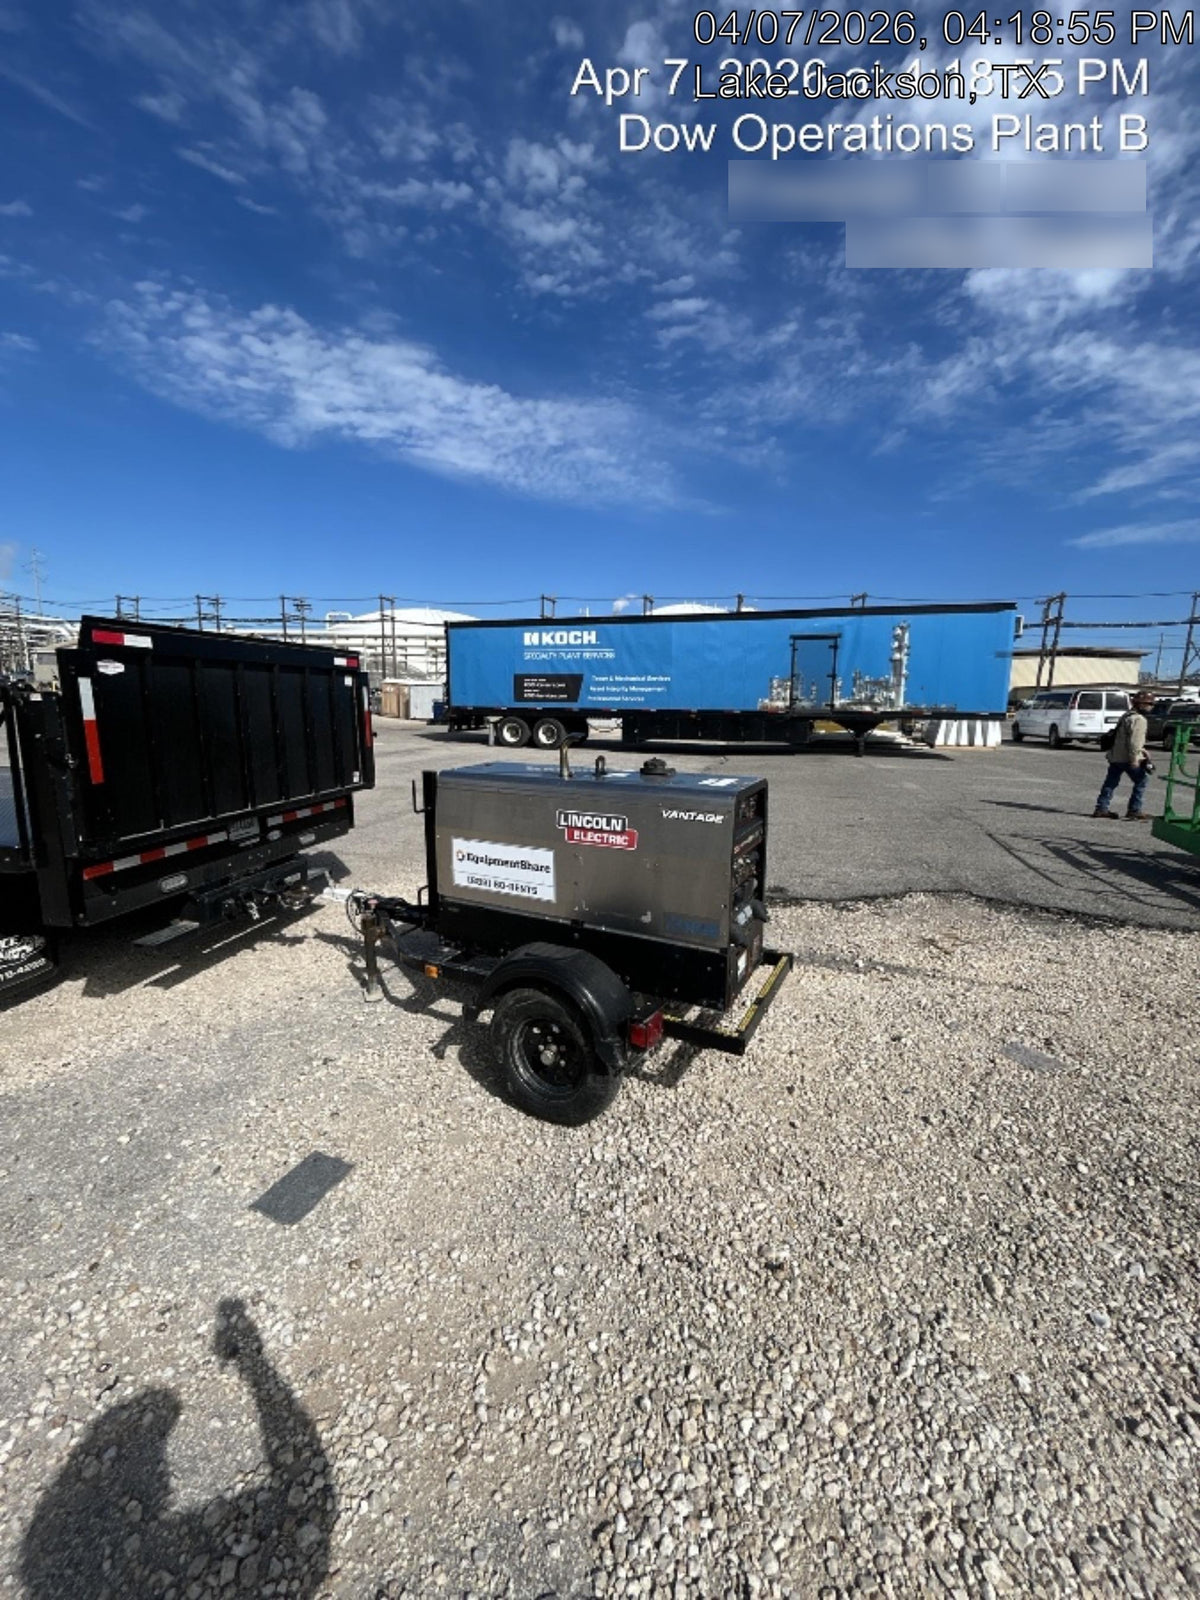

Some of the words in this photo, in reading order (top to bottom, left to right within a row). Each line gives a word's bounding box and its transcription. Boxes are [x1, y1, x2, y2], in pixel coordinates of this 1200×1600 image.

[541, 630, 597, 646] KOCH
[559, 814, 623, 831] LINCOLN
[661, 809, 725, 824] VANTAGE
[573, 830, 630, 846] ELECTRIC
[466, 852, 551, 873] EquipmentShare
